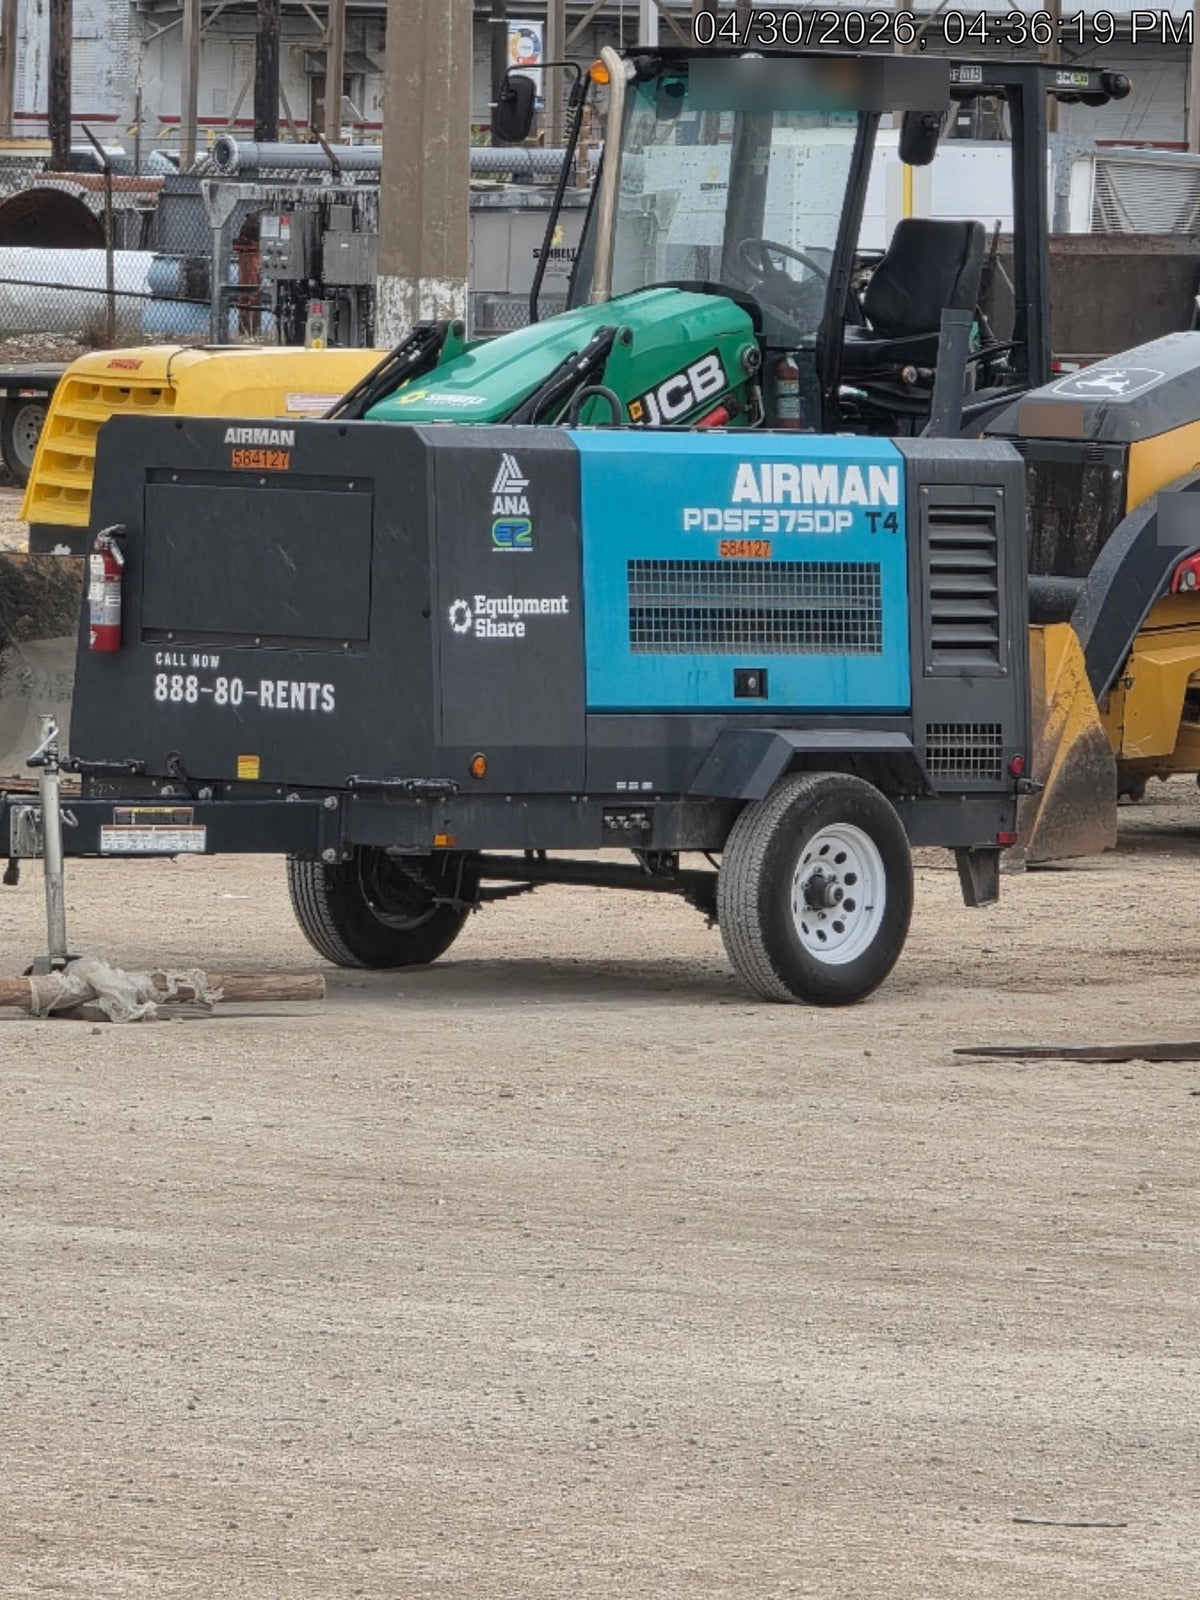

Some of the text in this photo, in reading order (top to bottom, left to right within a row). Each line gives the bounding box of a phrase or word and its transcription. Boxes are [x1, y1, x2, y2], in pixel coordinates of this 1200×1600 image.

[634, 355, 725, 426] JCB
[224, 427, 296, 447] AIRMAN
[233, 448, 287, 467] 584127
[732, 463, 899, 506] AIRMAN
[492, 495, 531, 515] ANA
[683, 507, 899, 534] PDSF375DP T4
[719, 540, 771, 557] 584127
[474, 594, 569, 619] Equipment
[475, 618, 526, 638] Share
[155, 651, 221, 669] CALL NOW
[154, 673, 336, 713] 888-80-RENTS
